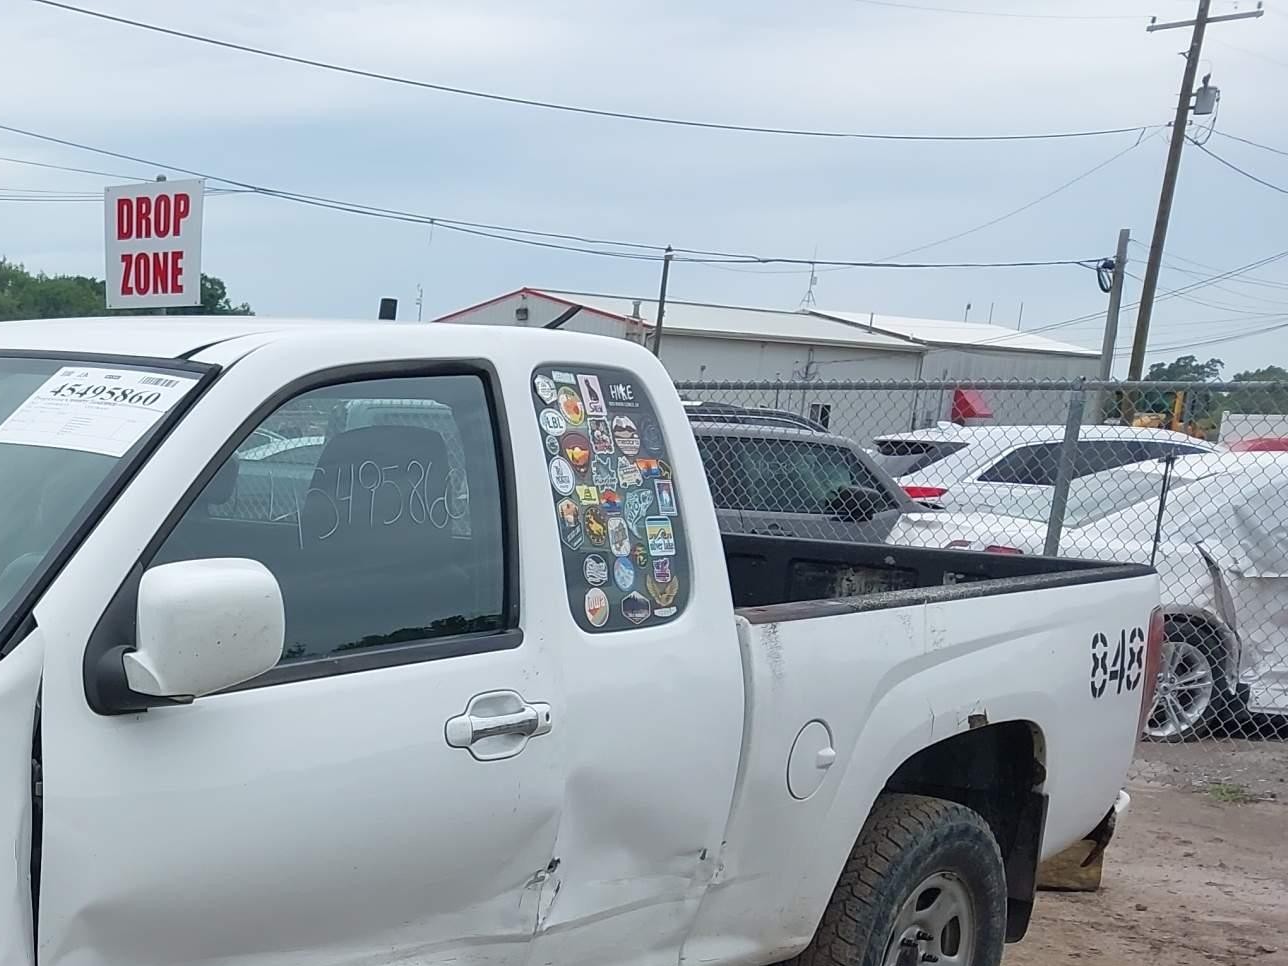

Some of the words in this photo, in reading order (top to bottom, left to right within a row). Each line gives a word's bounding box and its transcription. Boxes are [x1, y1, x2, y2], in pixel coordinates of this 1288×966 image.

[116, 193, 190, 240] DROP
[120, 250, 184, 296] ZONE
[49, 382, 161, 407] 45495860
[268, 459, 471, 551] 45495860
[1090, 626, 1145, 699] 848
